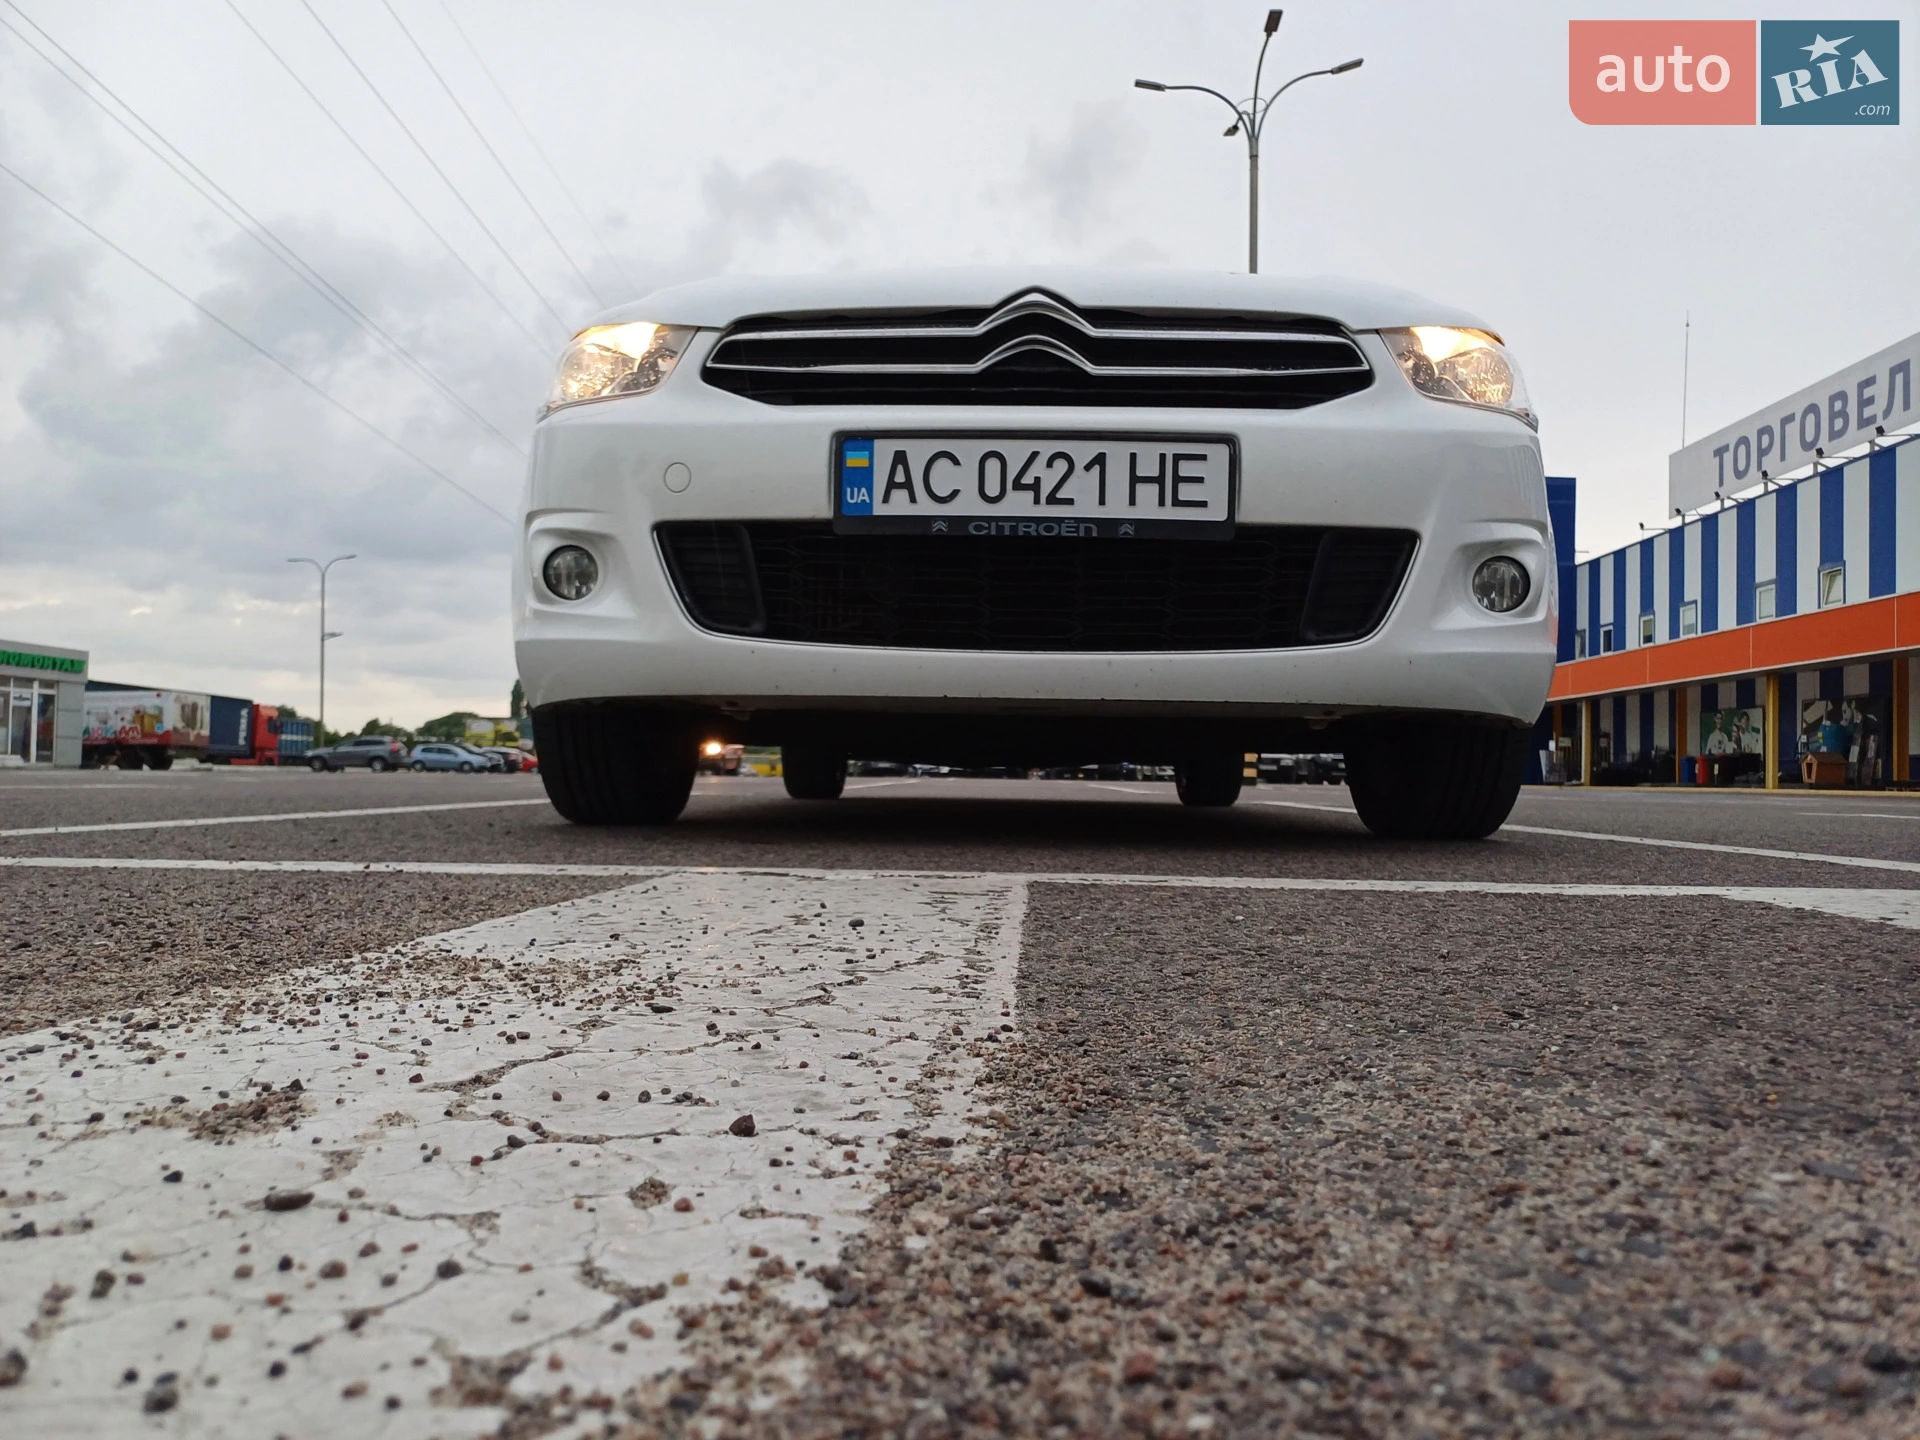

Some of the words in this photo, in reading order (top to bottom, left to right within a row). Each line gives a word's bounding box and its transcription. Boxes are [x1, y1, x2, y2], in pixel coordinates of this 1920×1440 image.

[1713, 358, 1911, 488] ТОРГОВЕЛ
[846, 487, 870, 504] UA
[881, 450, 962, 505] AC
[978, 449, 1107, 507] 0421
[1128, 452, 1209, 508] HE
